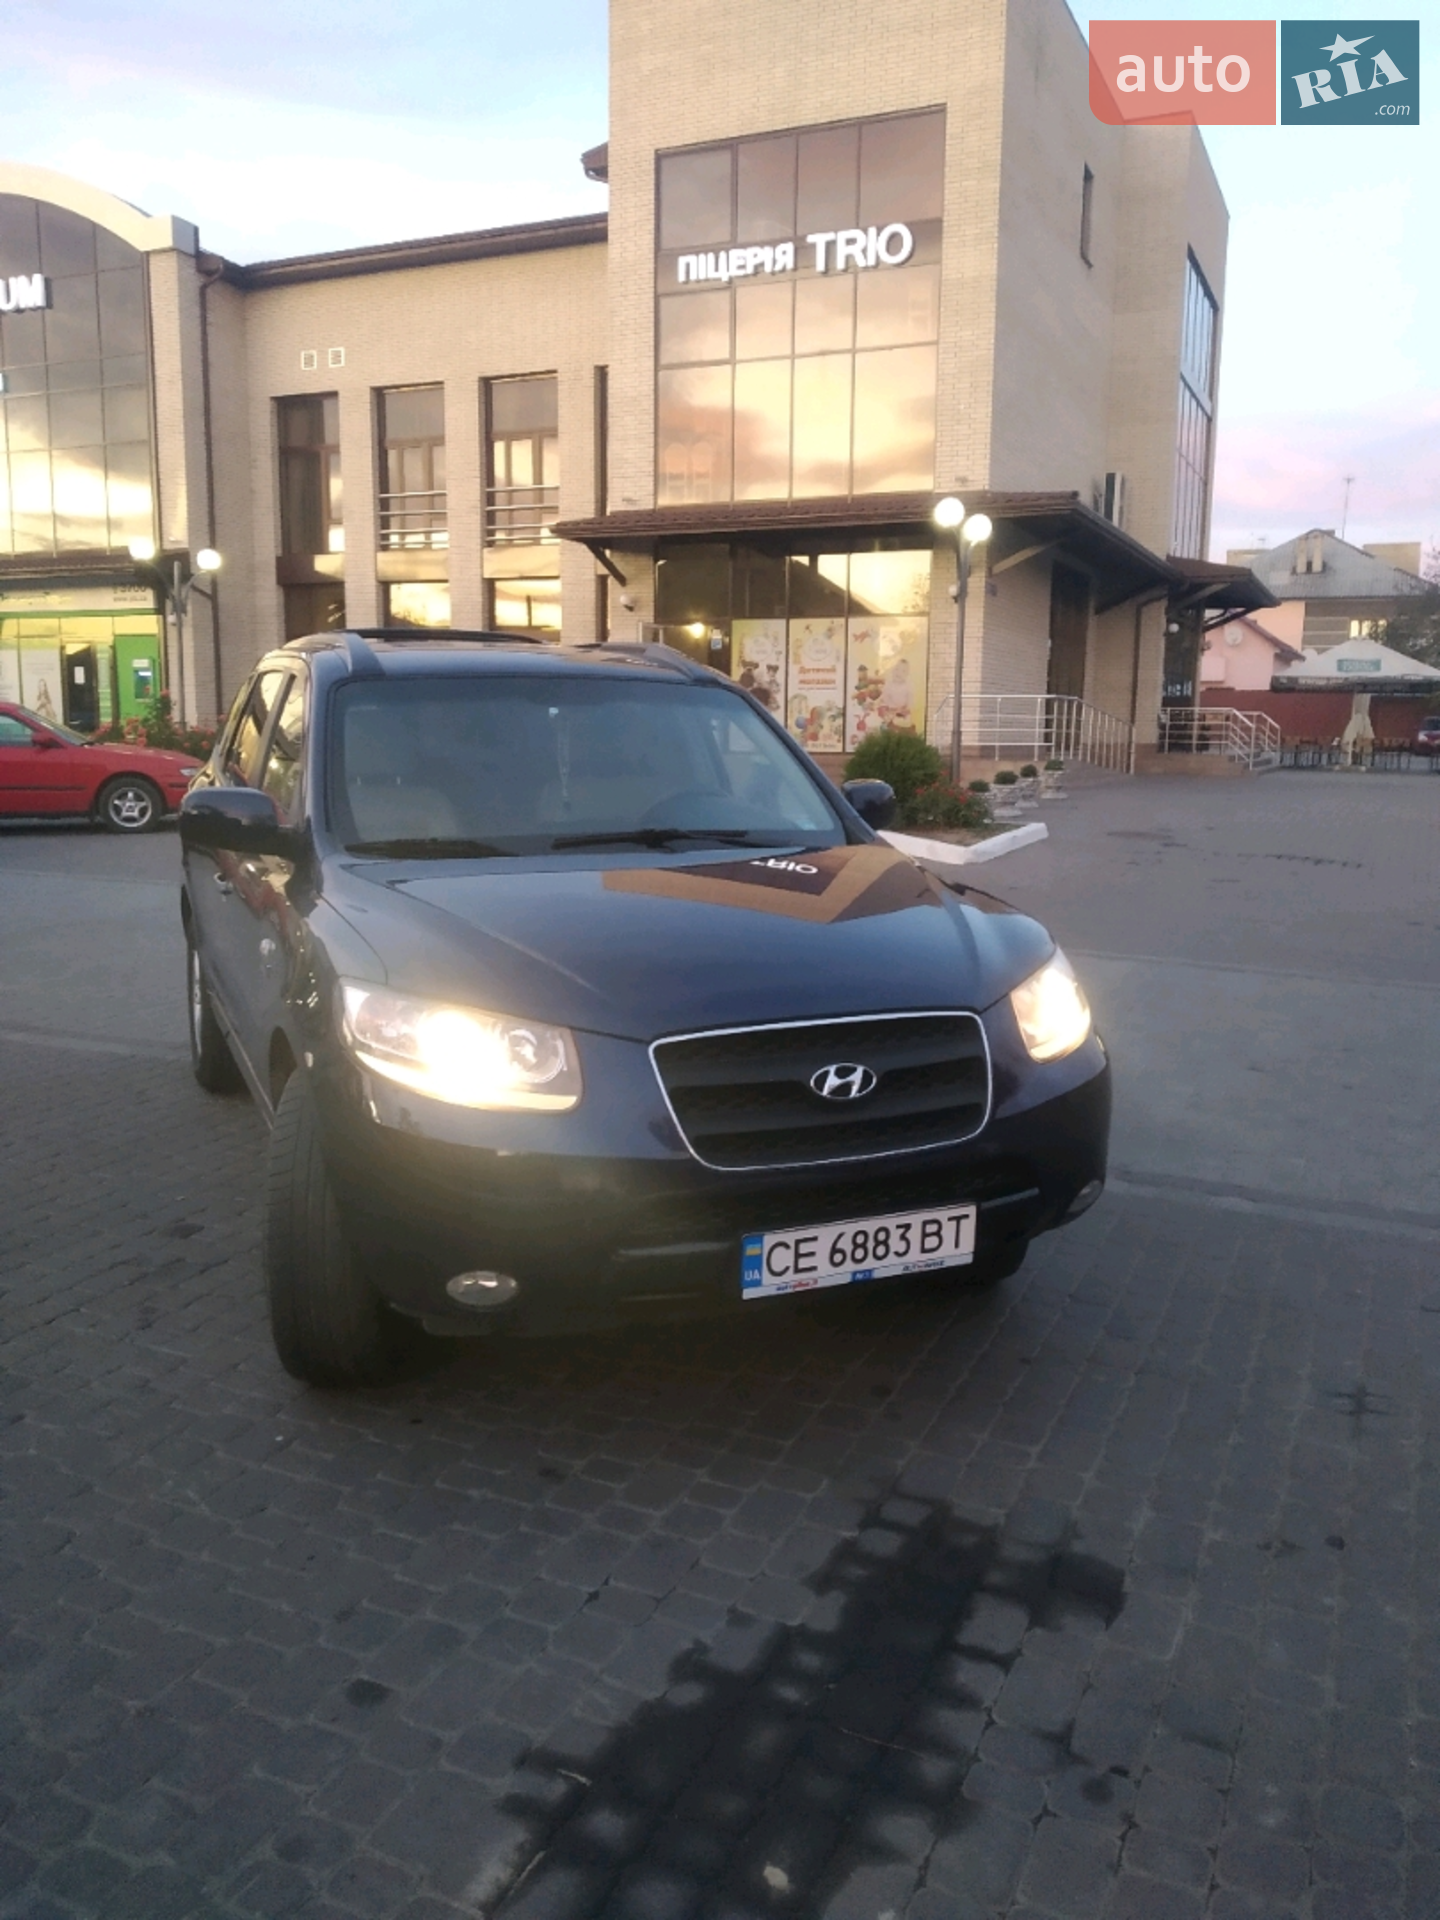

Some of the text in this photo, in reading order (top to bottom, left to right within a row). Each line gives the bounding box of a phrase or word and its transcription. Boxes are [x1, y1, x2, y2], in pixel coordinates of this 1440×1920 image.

[677, 223, 914, 283] ПІЦЕРІЯ TRIO
[744, 1270, 762, 1281] UA
[766, 1214, 971, 1278] CE 6883 BT
